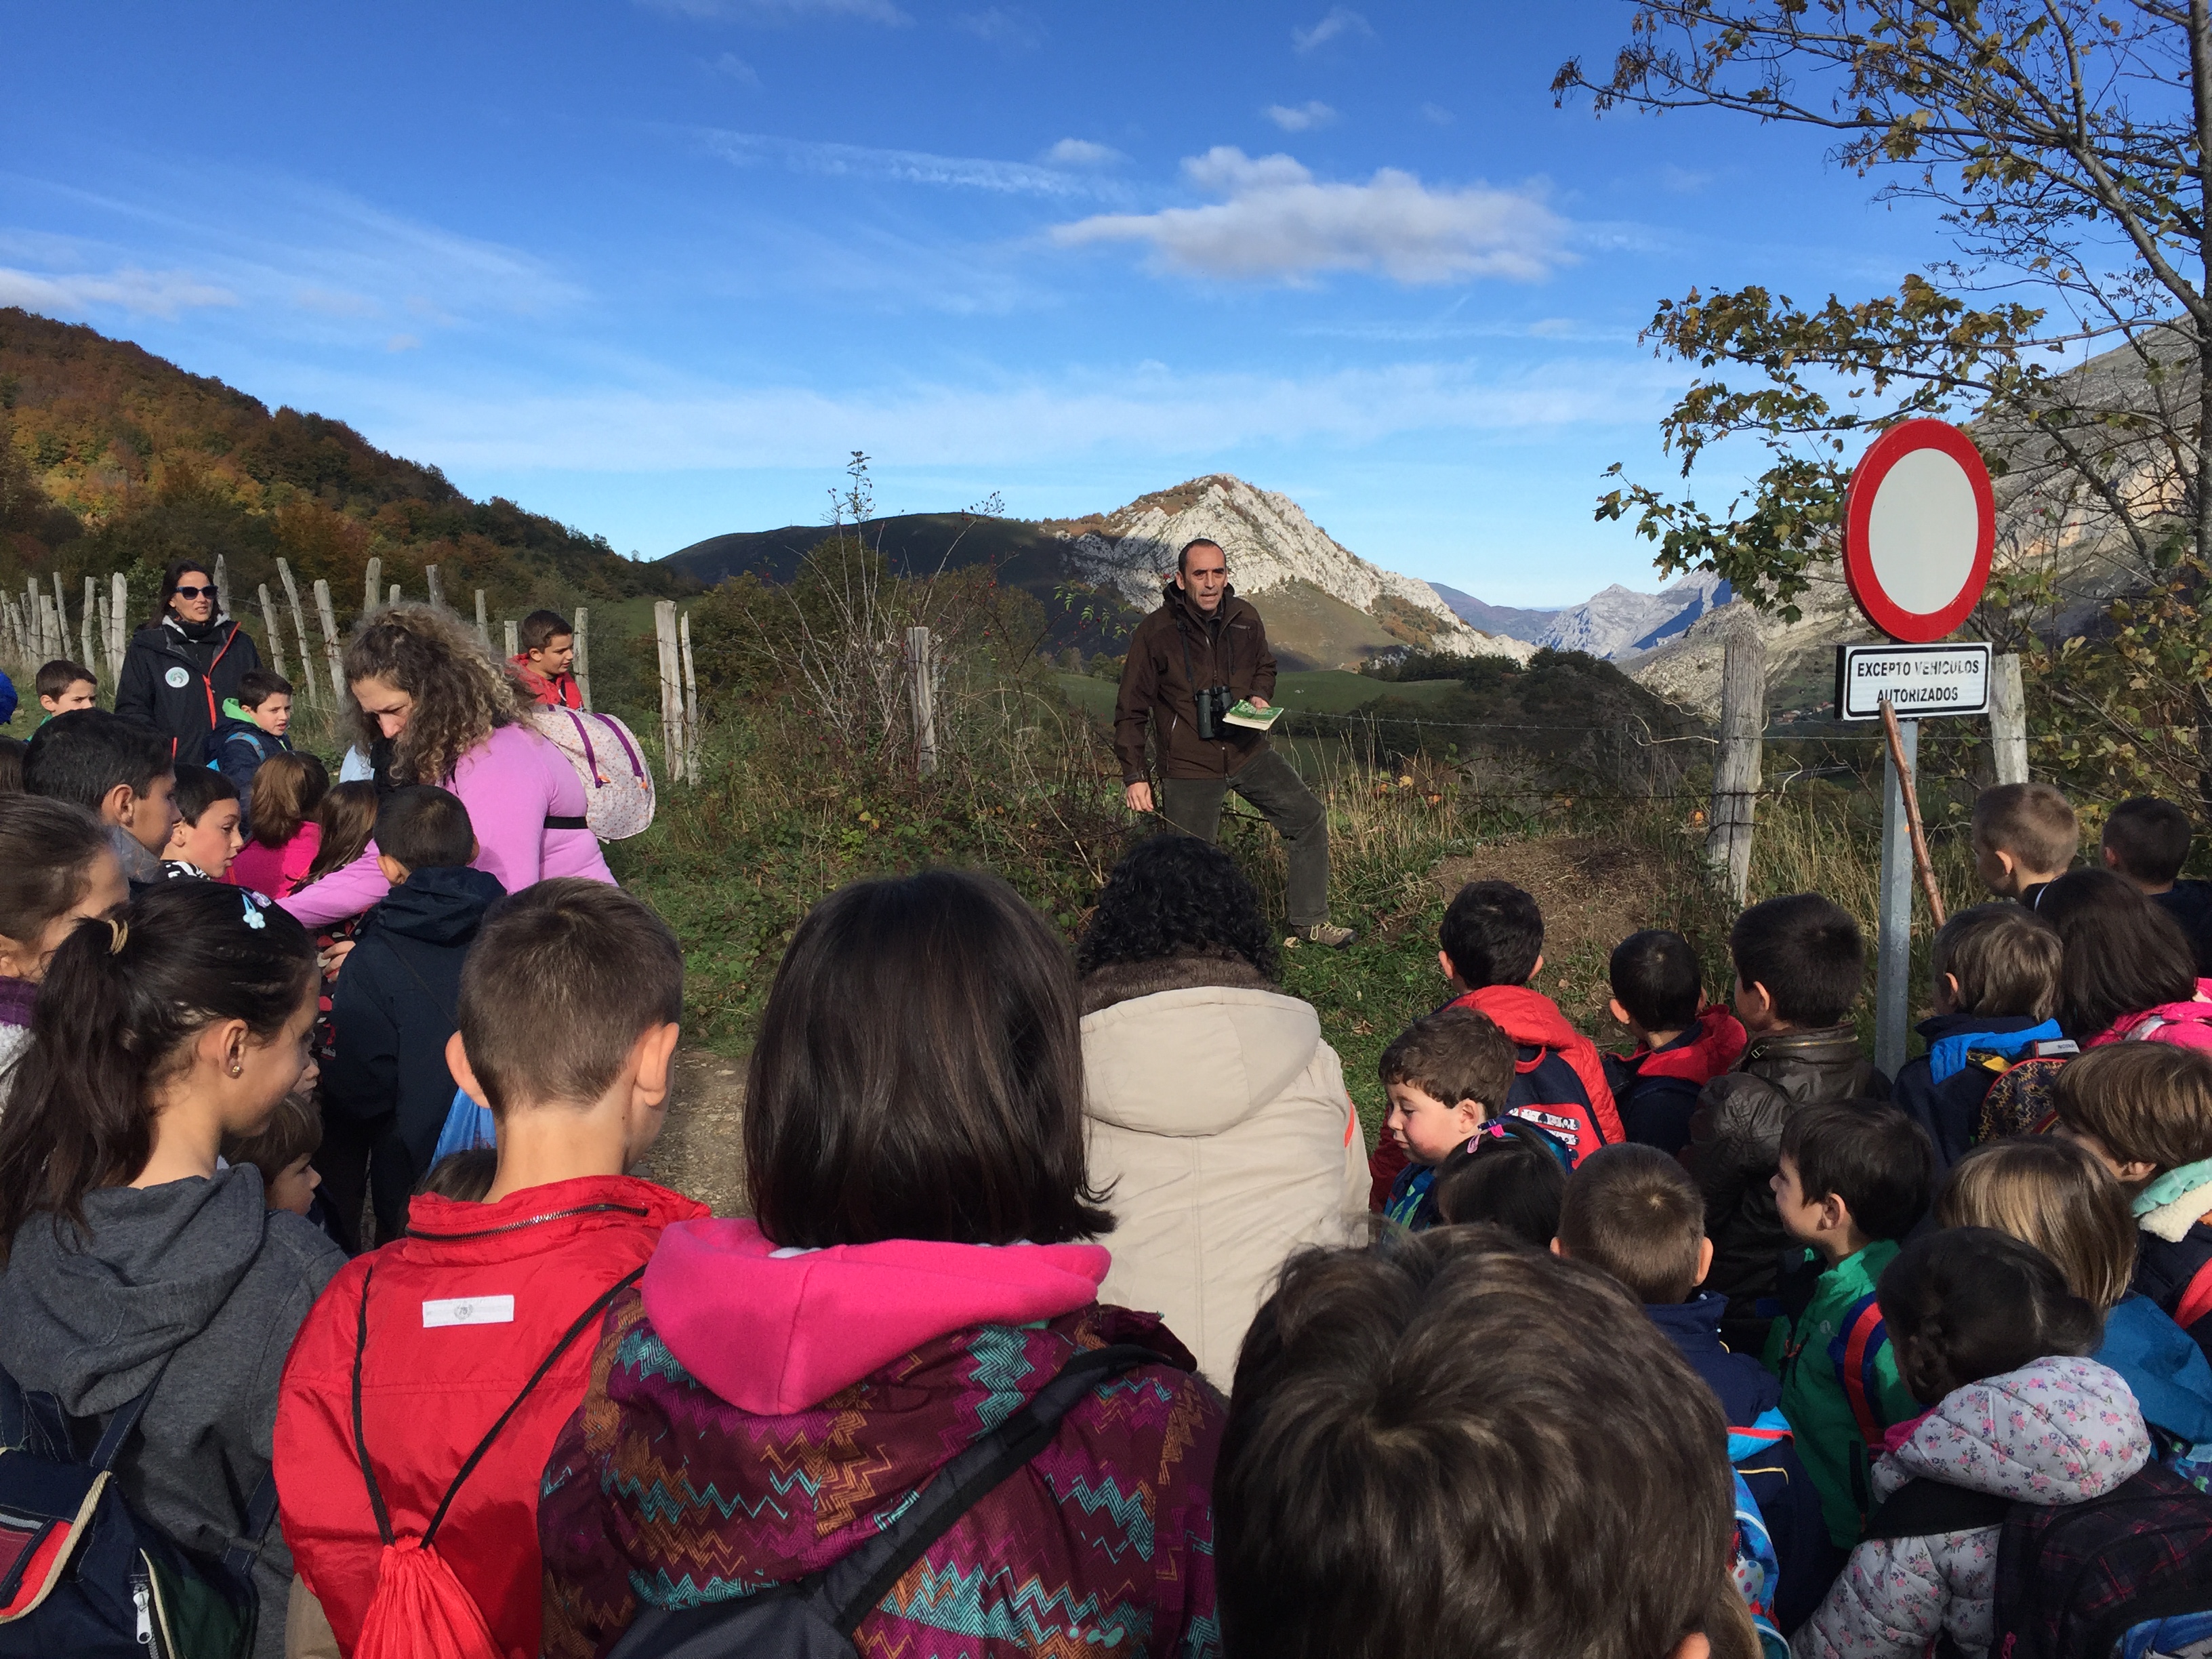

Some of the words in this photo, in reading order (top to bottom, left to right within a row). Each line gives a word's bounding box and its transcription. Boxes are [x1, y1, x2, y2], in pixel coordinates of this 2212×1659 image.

[1858, 661, 1910, 677] EXCEPTO
[1915, 659, 1980, 675] VEHICULOS
[1877, 687, 1958, 703] AUTORIZADOS
